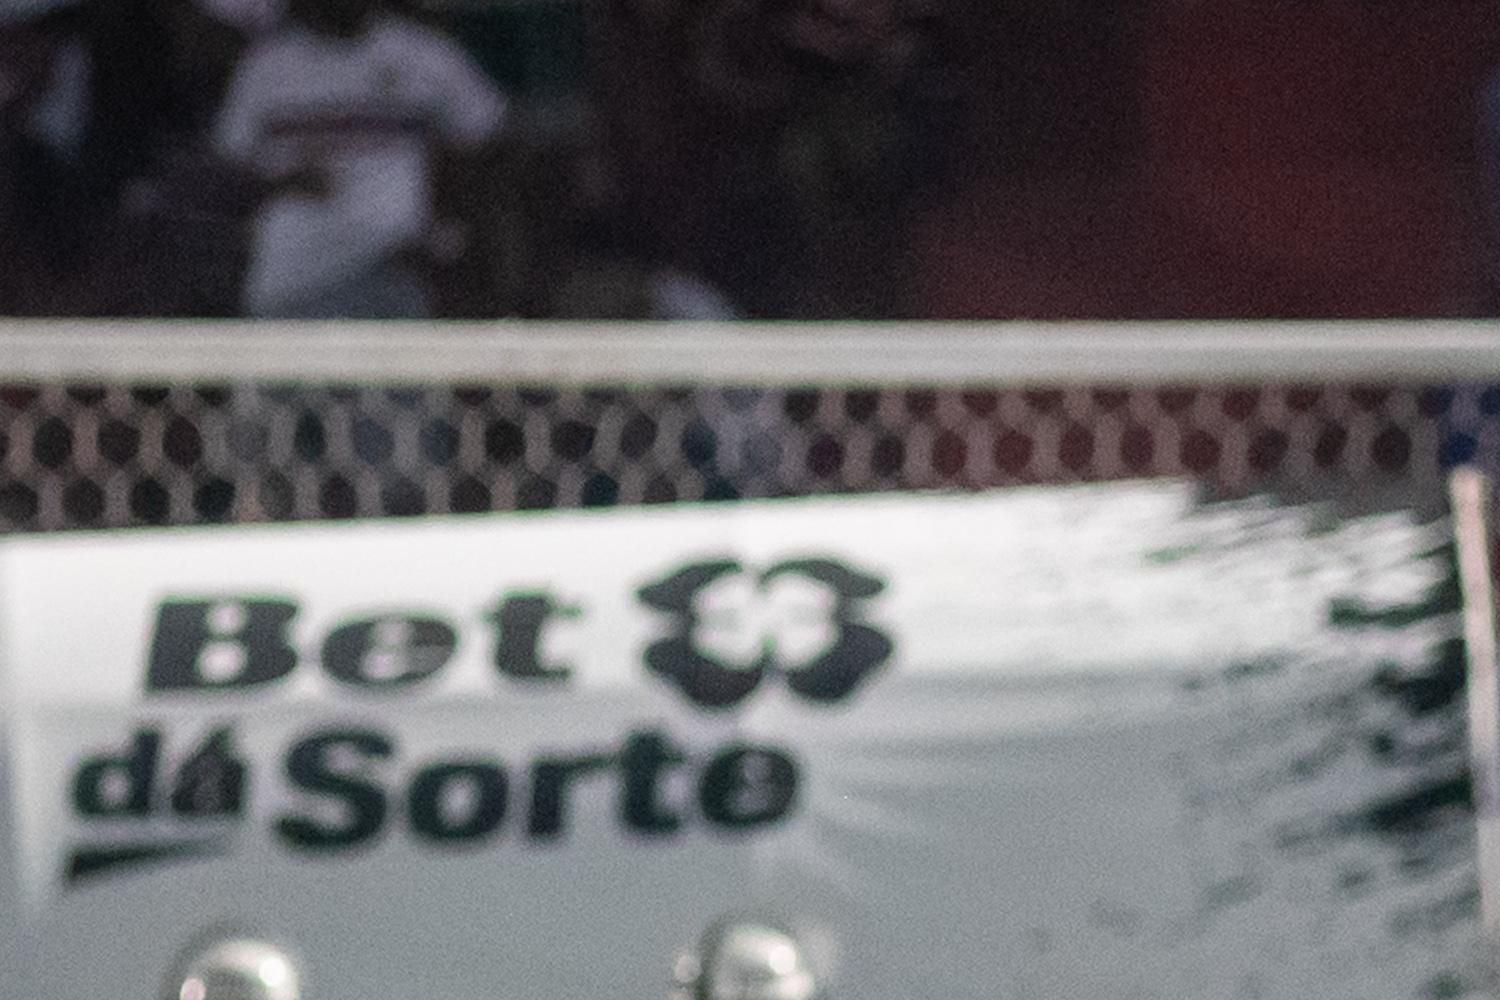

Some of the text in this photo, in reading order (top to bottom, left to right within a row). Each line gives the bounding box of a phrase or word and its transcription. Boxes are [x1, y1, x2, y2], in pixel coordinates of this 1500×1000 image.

[147, 592, 580, 692] Bet
[70, 723, 800, 848] dá Sorte
